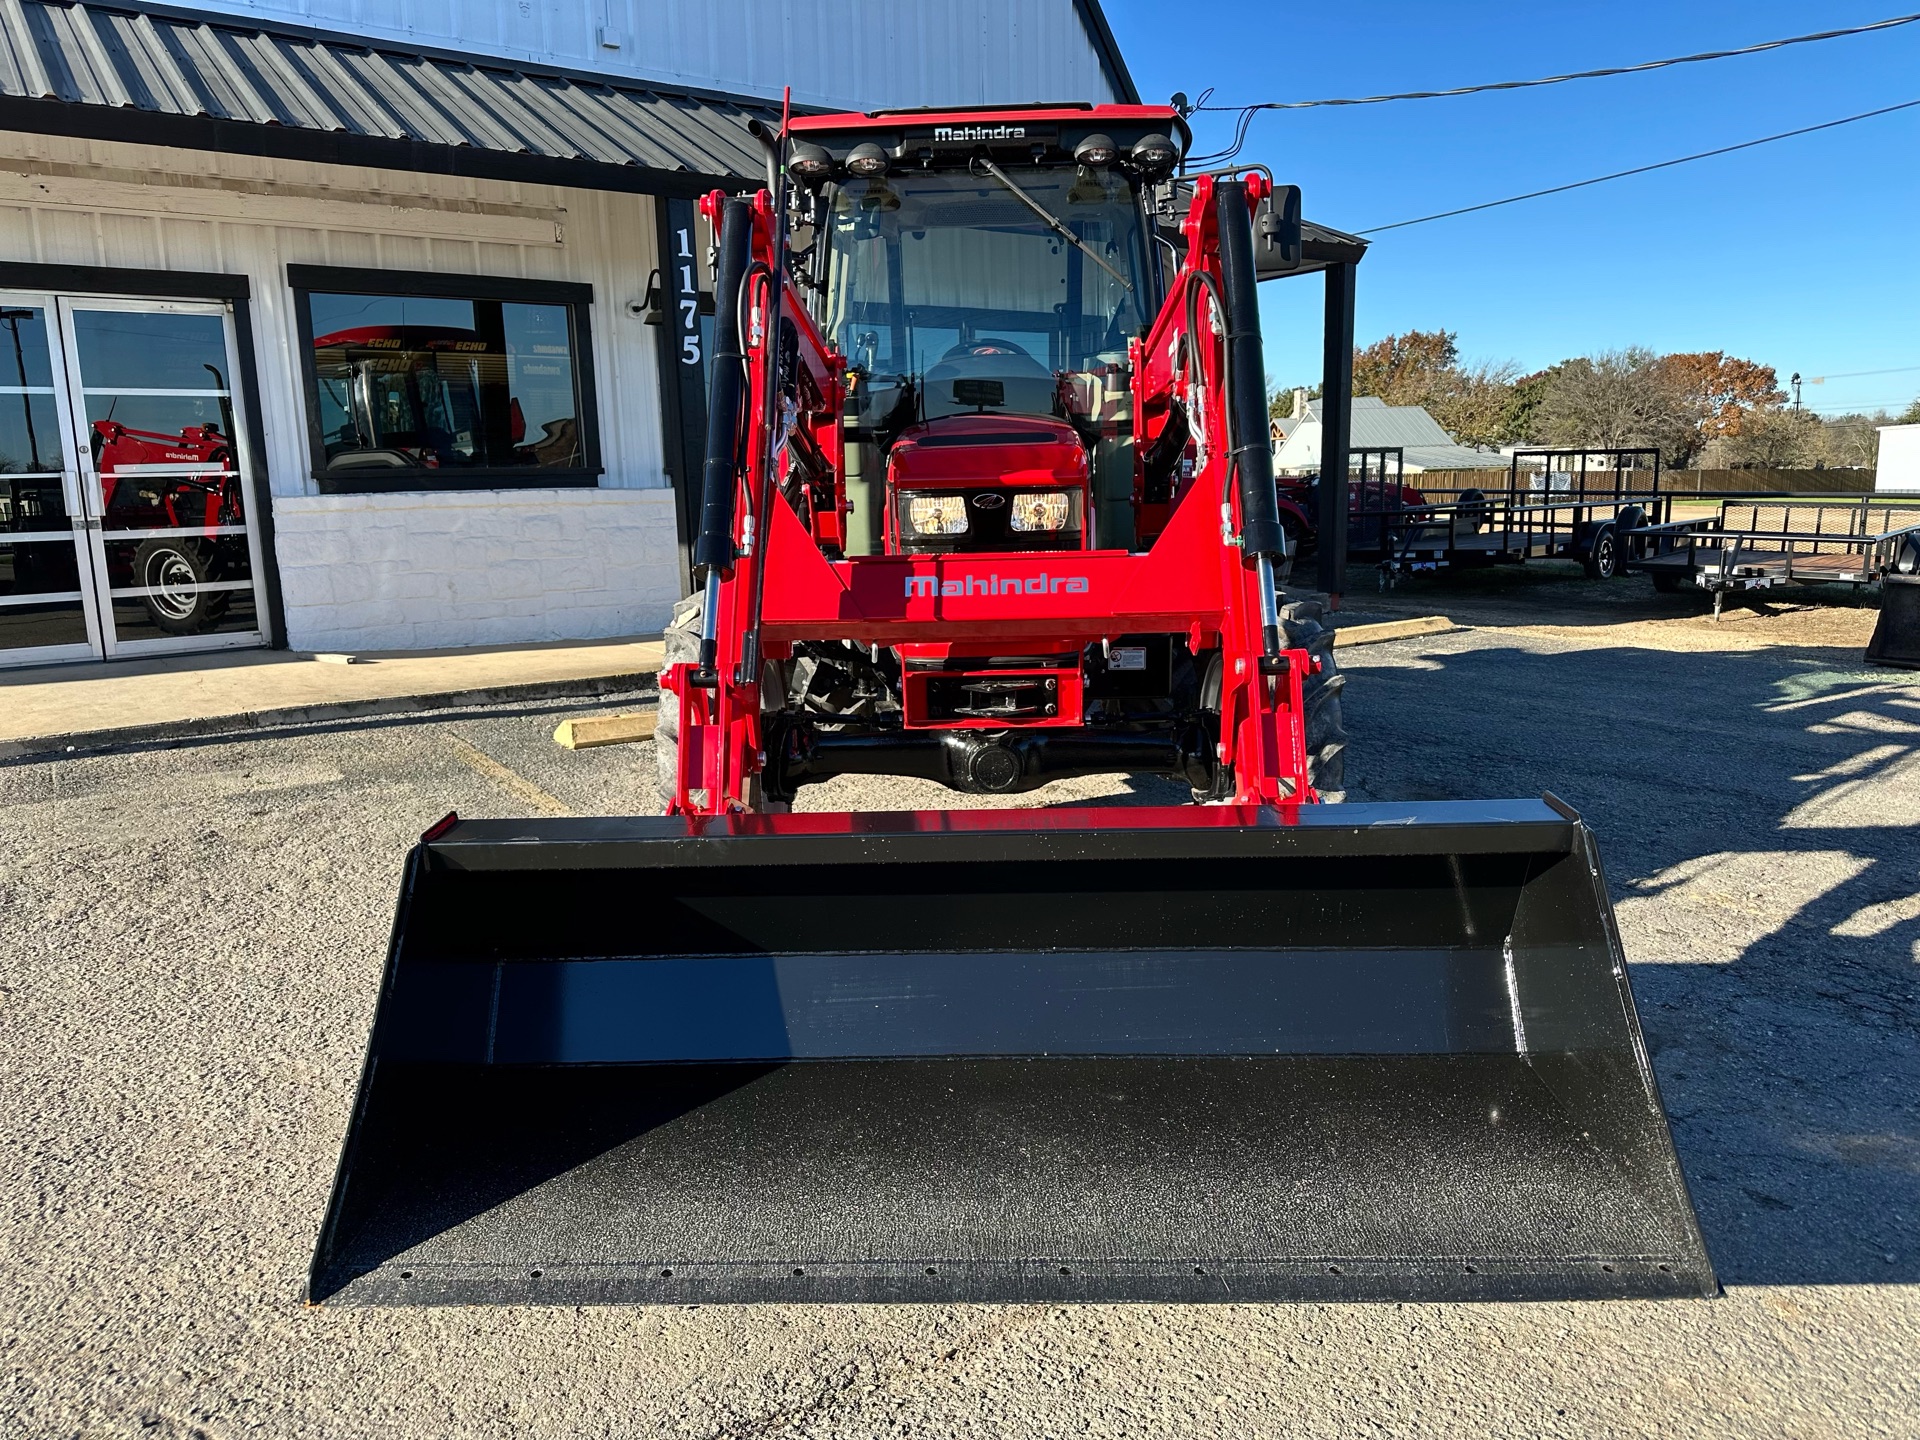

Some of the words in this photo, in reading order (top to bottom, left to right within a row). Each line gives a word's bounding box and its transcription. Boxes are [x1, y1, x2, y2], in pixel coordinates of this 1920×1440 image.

[934, 125, 1025, 141] Mahindra
[677, 228, 700, 365] 1175
[366, 338, 401, 349] ECHO
[455, 341, 487, 351] ECHO
[370, 358, 412, 372] ECHO
[904, 573, 1090, 598] Mahindra
